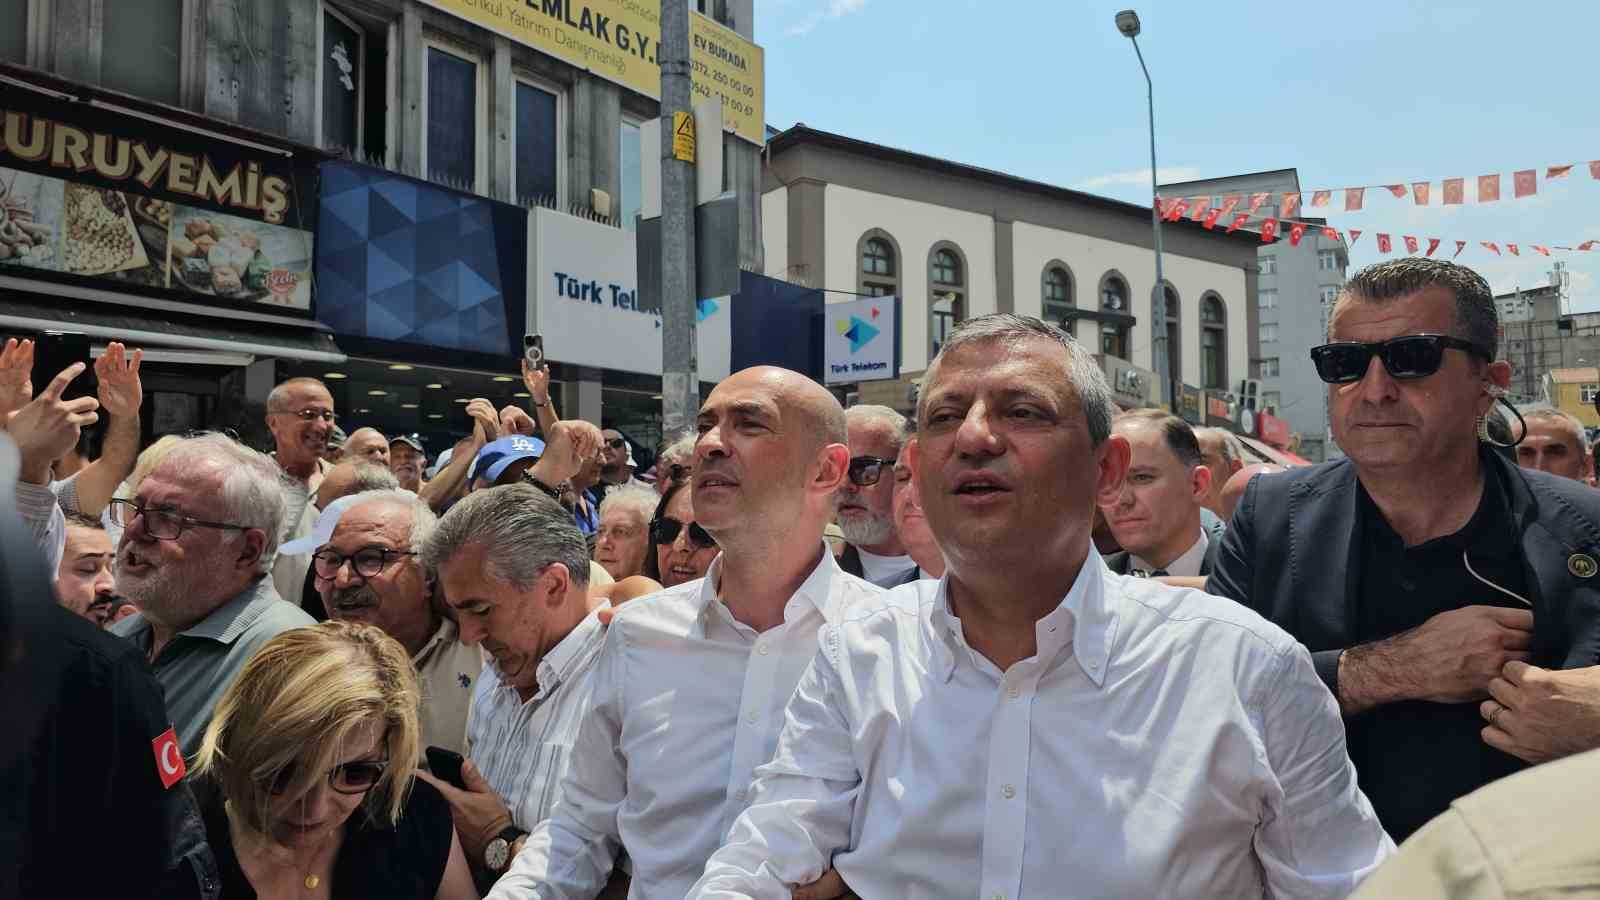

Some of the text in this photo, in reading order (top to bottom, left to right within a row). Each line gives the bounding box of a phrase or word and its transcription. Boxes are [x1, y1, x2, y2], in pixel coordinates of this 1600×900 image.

[616, 24, 661, 66] G.Y.
[694, 33, 707, 50] EV
[708, 41, 747, 71] BURADA
[554, 272, 602, 304] Türk
[831, 361, 888, 374] Türk Telekom
